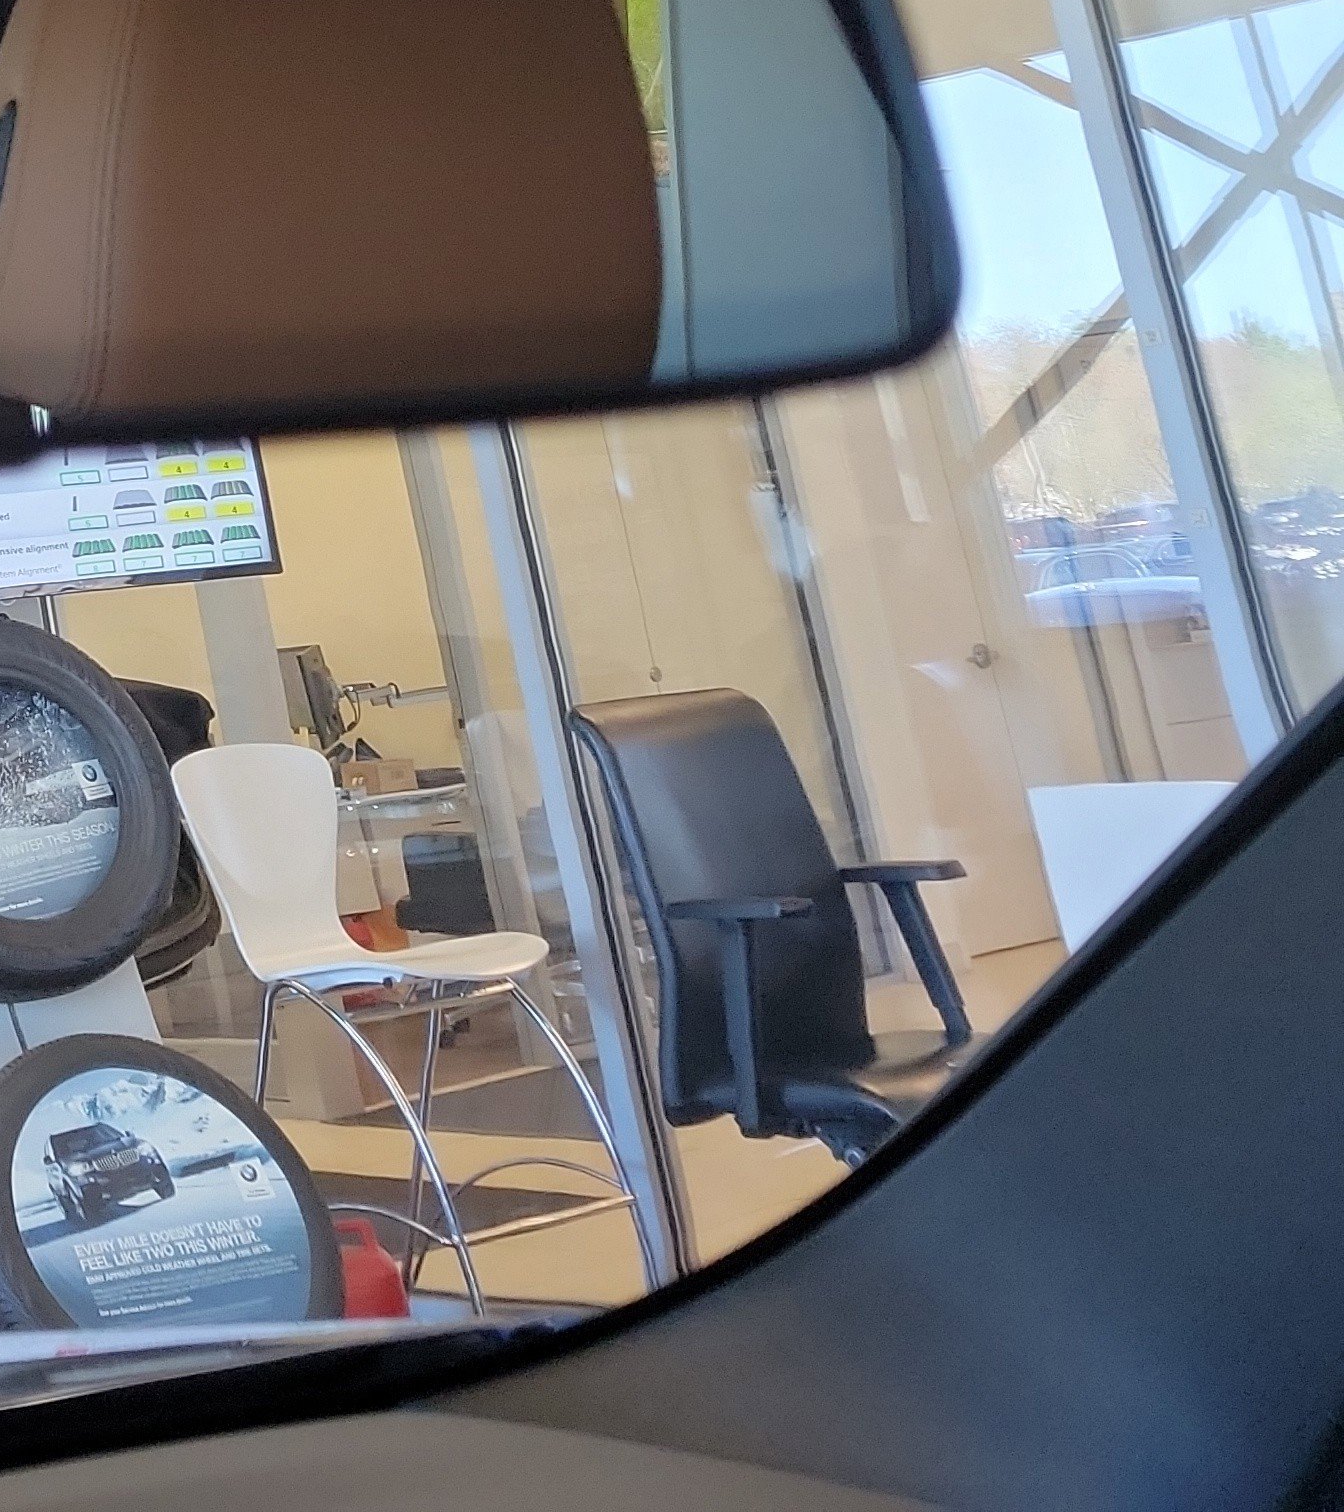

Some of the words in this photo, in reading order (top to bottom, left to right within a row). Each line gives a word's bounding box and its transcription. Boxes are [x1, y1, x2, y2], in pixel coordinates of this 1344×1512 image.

[176, 466, 182, 474] 4
[184, 510, 190, 518] 4
[232, 506, 238, 514] 4
[26, 541, 69, 555] alignment
[2, 839, 43, 858] WINTER
[47, 832, 71, 846] THIS
[74, 1240, 115, 1259] EVERY
[117, 1232, 152, 1250] MILE
[153, 1223, 204, 1244] DOESN'T
[206, 1218, 243, 1235] HAVE
[245, 1214, 262, 1228] TO
[80, 1254, 114, 1272] FEEL
[114, 1250, 143, 1267] LIKE
[145, 1245, 175, 1262] TWO
[176, 1239, 207, 1256] THIS
